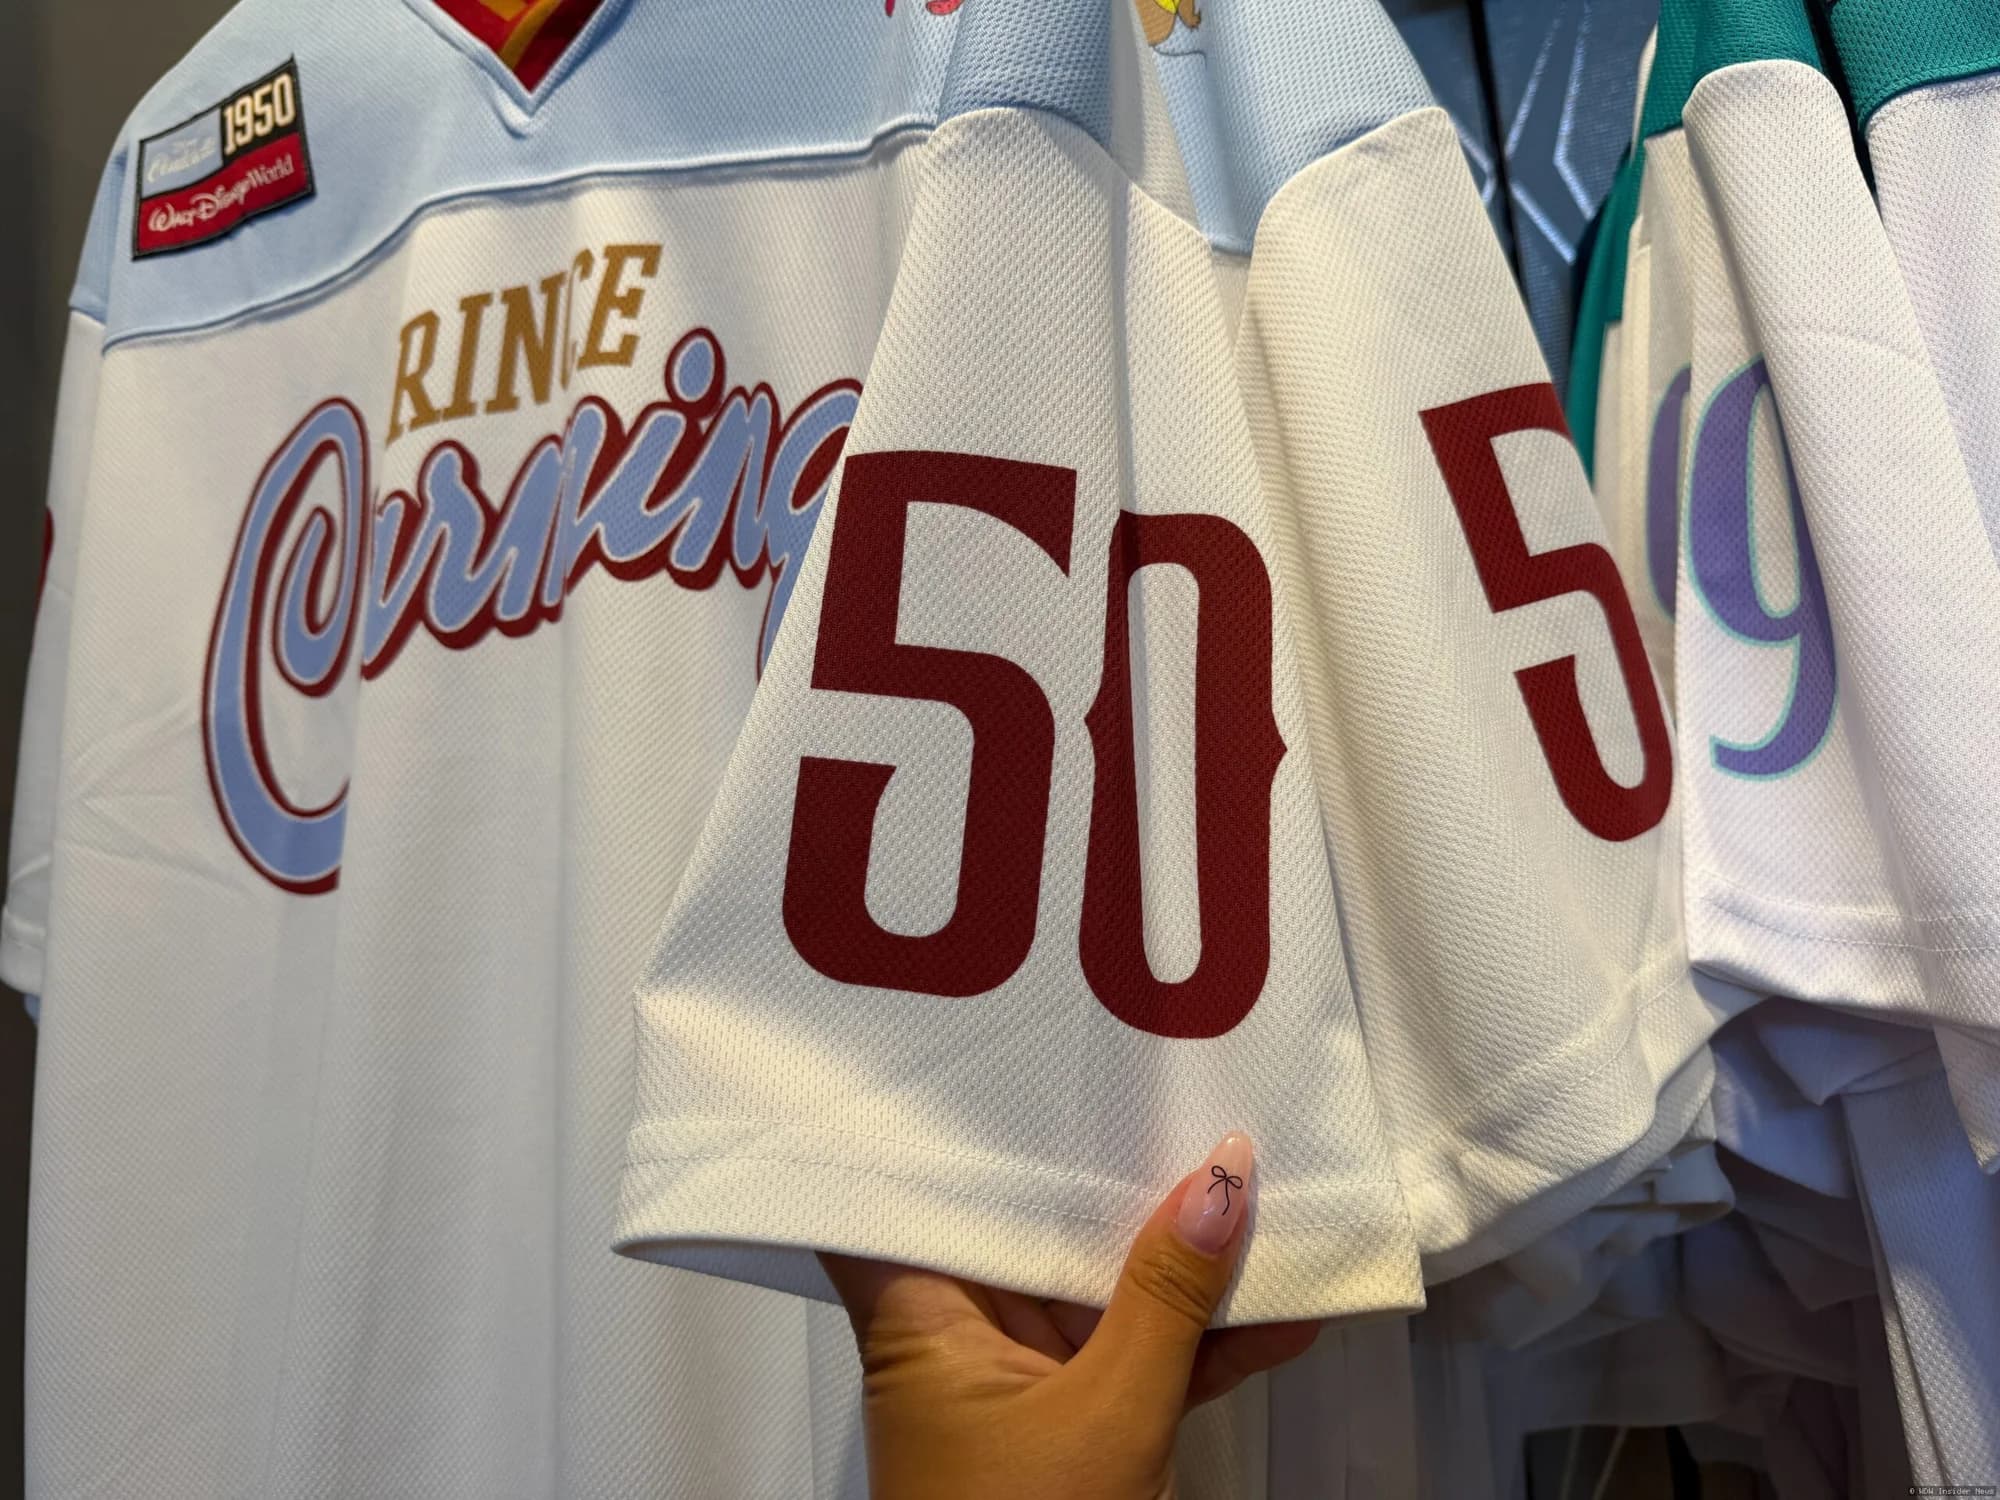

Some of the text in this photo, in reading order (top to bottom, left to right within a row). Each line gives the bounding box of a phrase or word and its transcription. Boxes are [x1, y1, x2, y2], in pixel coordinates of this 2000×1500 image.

[189, 179, 247, 221] Disney
[245, 153, 295, 188] World
[223, 72, 297, 156] 1950
[1686, 353, 1839, 782] 9
[782, 450, 1288, 1040] 50
